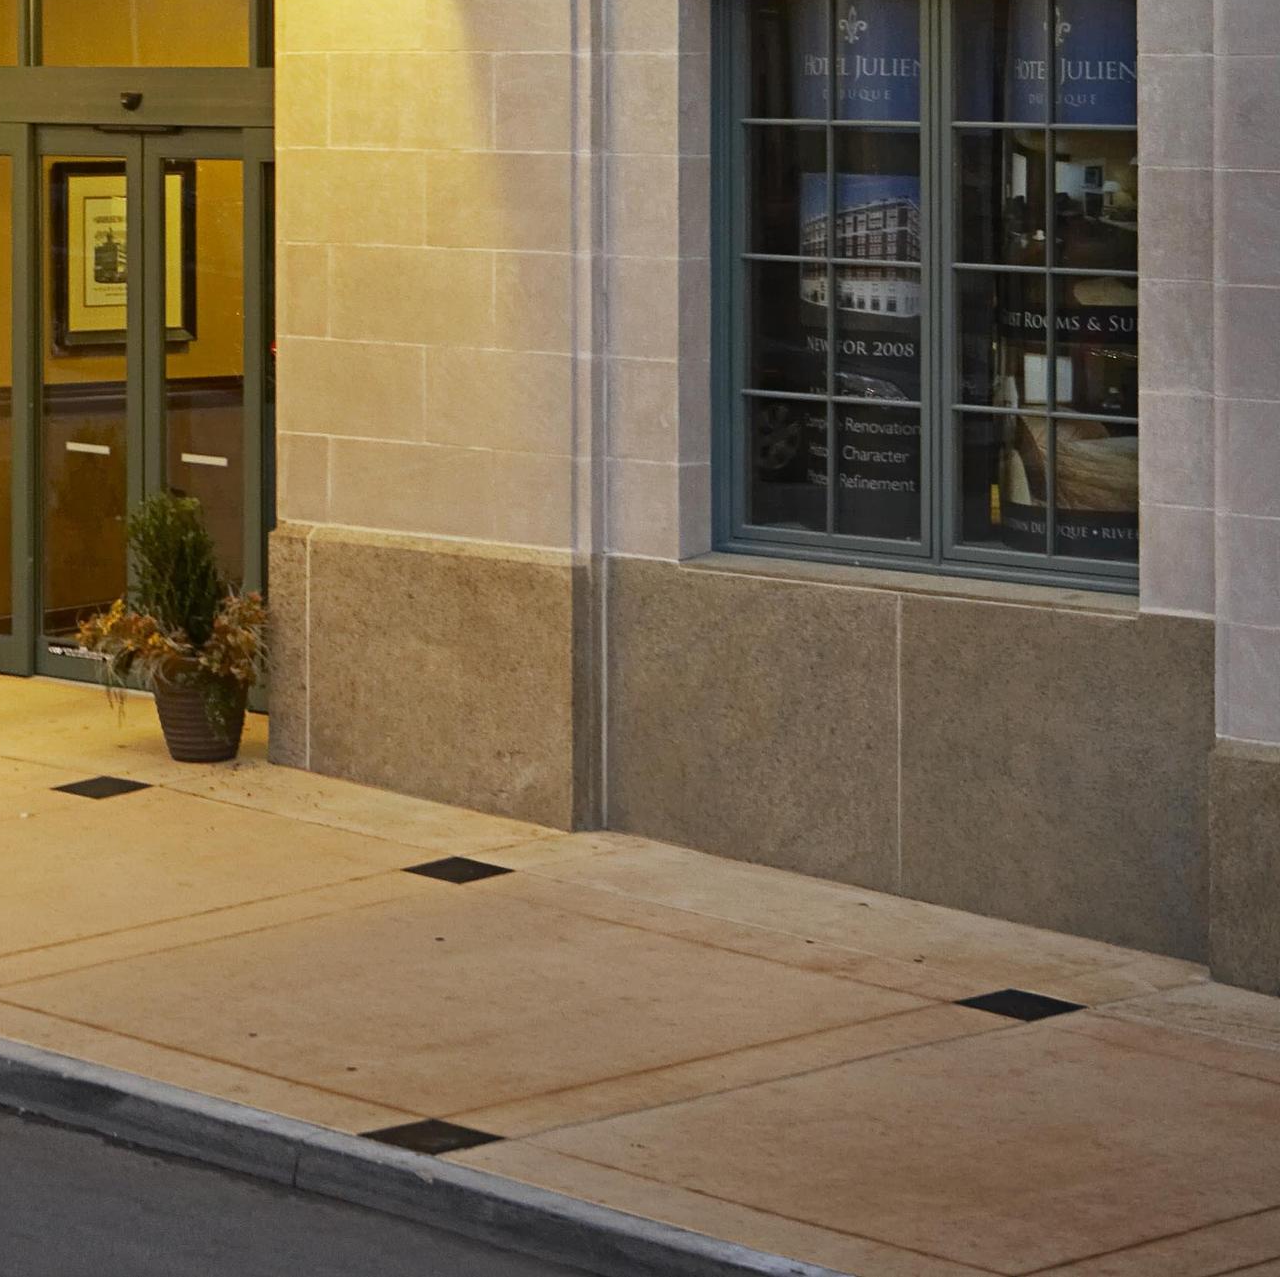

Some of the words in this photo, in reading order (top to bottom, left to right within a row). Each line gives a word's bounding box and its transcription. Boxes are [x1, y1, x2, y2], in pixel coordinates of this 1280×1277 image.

[1014, 58, 1047, 80] HOTE
[1060, 58, 1137, 85] JULIEN
[836, 340, 868, 356] FOR
[872, 341, 915, 357] 2008
[844, 416, 920, 436] Renovation
[842, 444, 910, 463] Character
[839, 473, 916, 493] Refinement
[1101, 526, 1137, 541] RIVE
